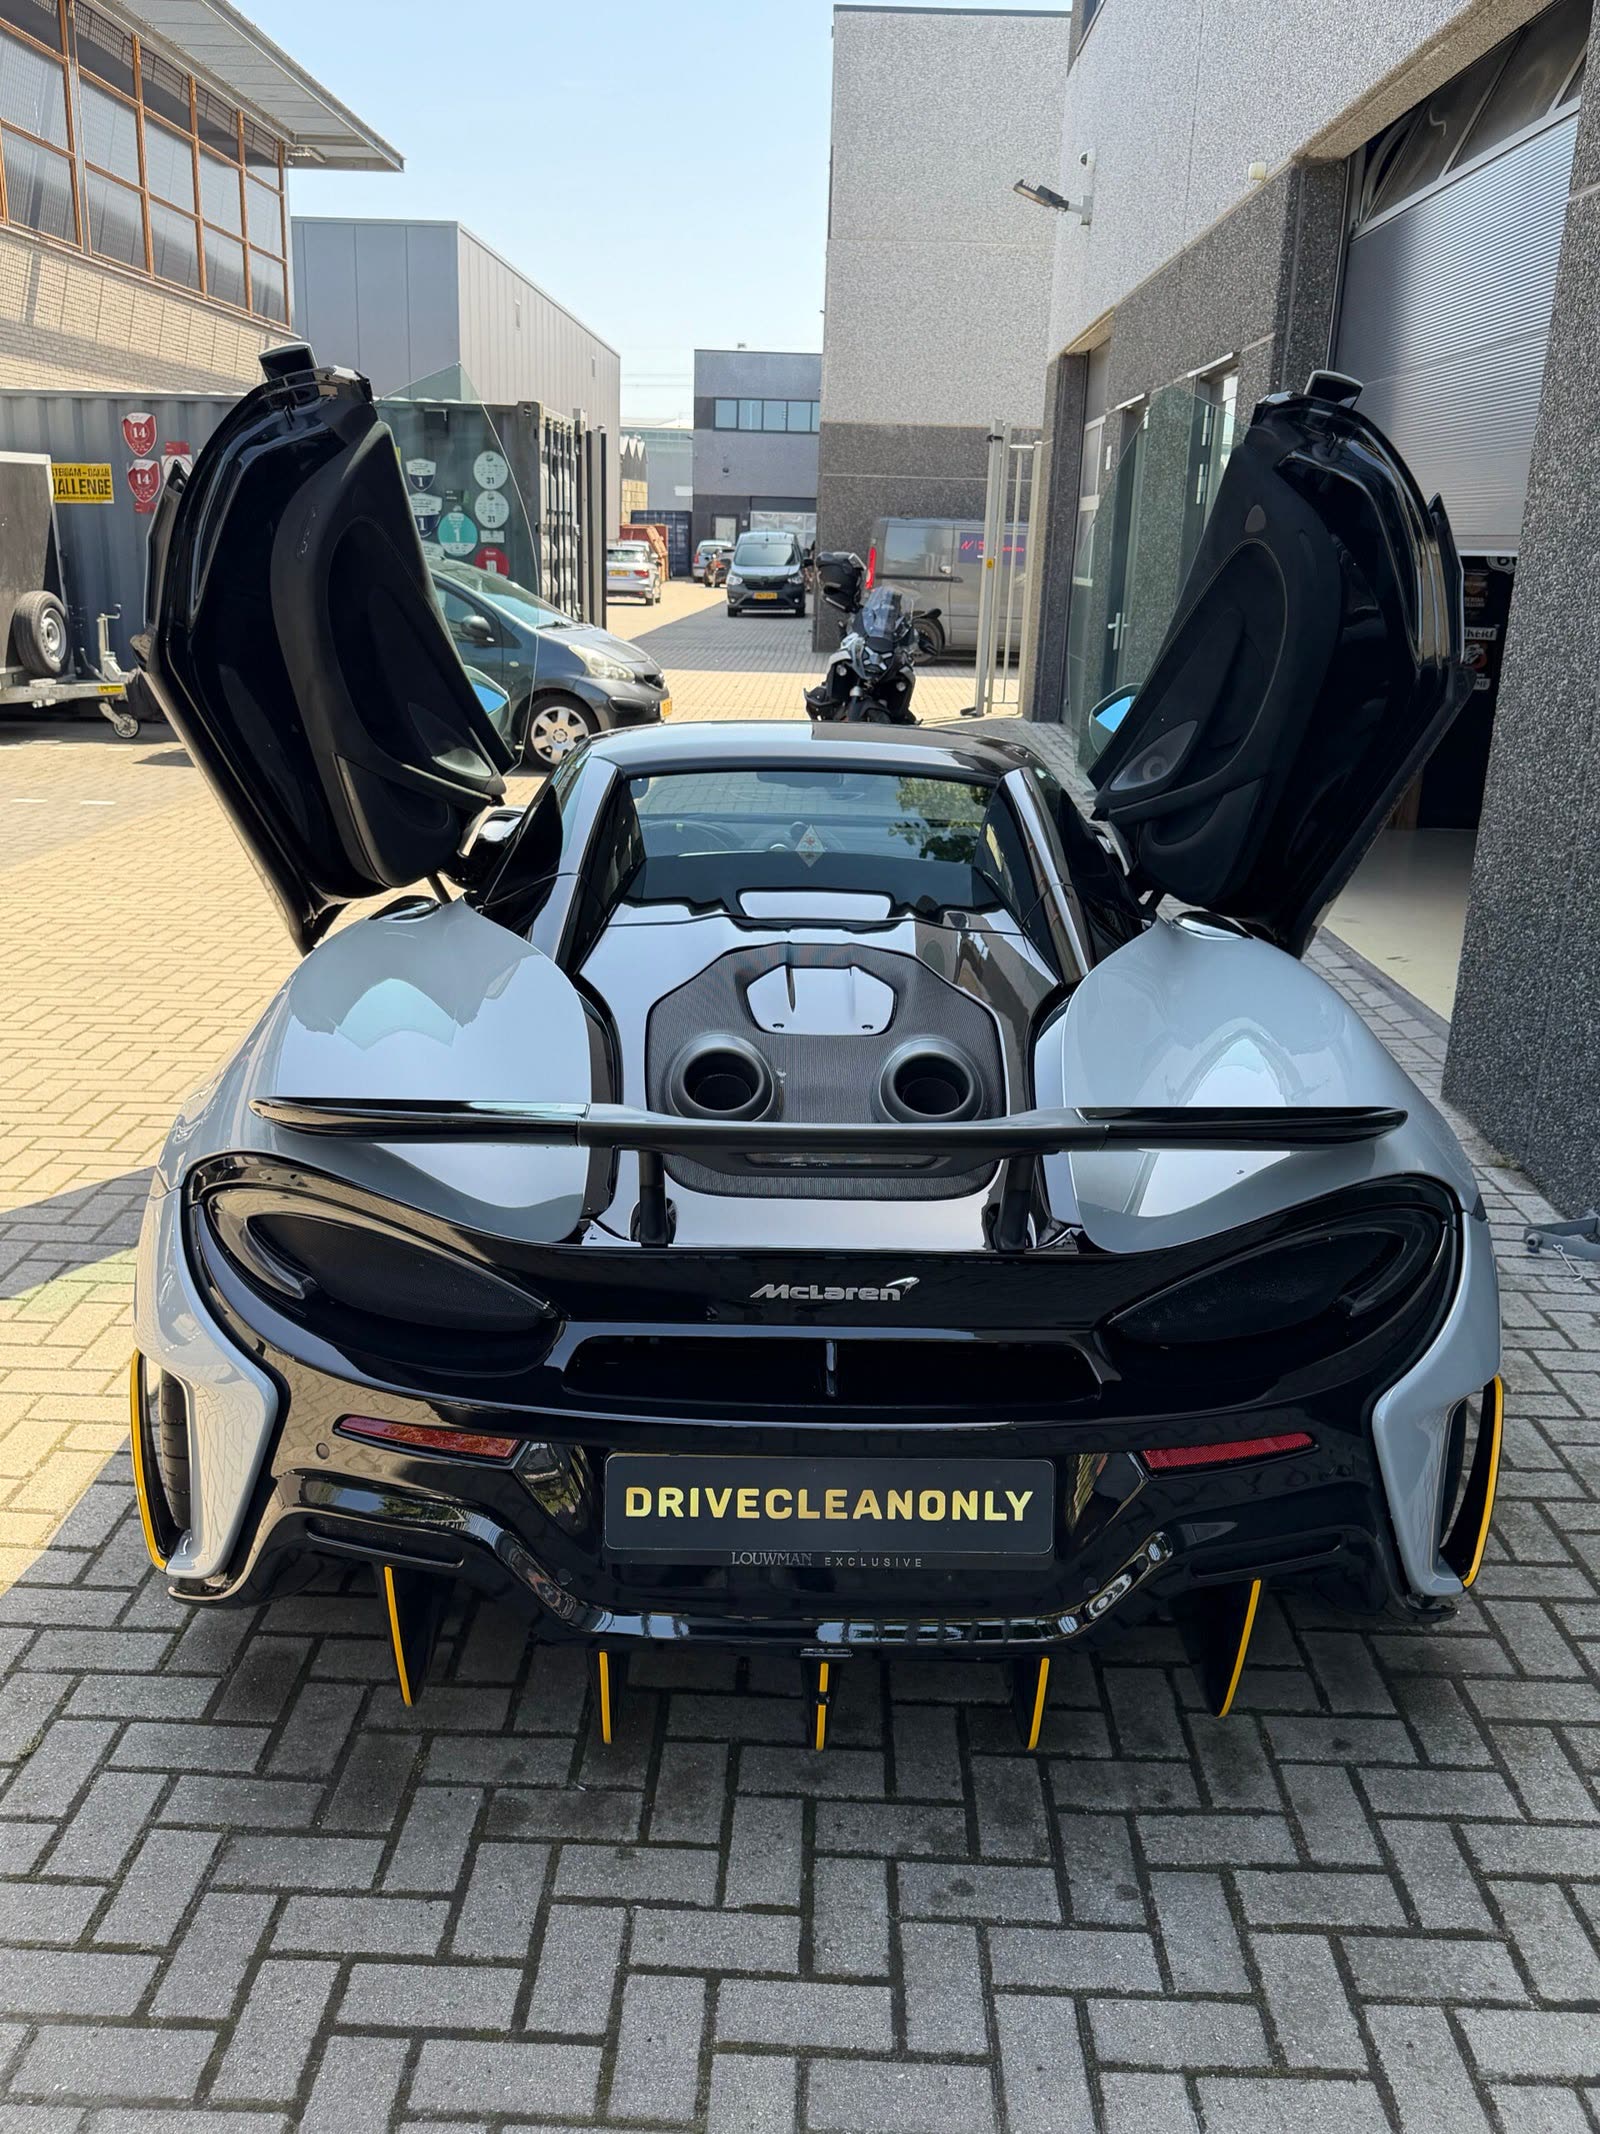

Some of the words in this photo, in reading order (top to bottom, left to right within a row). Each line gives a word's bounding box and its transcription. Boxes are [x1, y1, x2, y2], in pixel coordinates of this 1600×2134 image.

[132, 426, 147, 439] 14
[136, 473, 151, 485] 14
[750, 1282, 904, 1302] McLaren
[625, 1485, 1034, 1522] DRIVECLEANONLY
[731, 1550, 813, 1567] LOUWMAN
[824, 1556, 923, 1567] EXCLUSIVE
